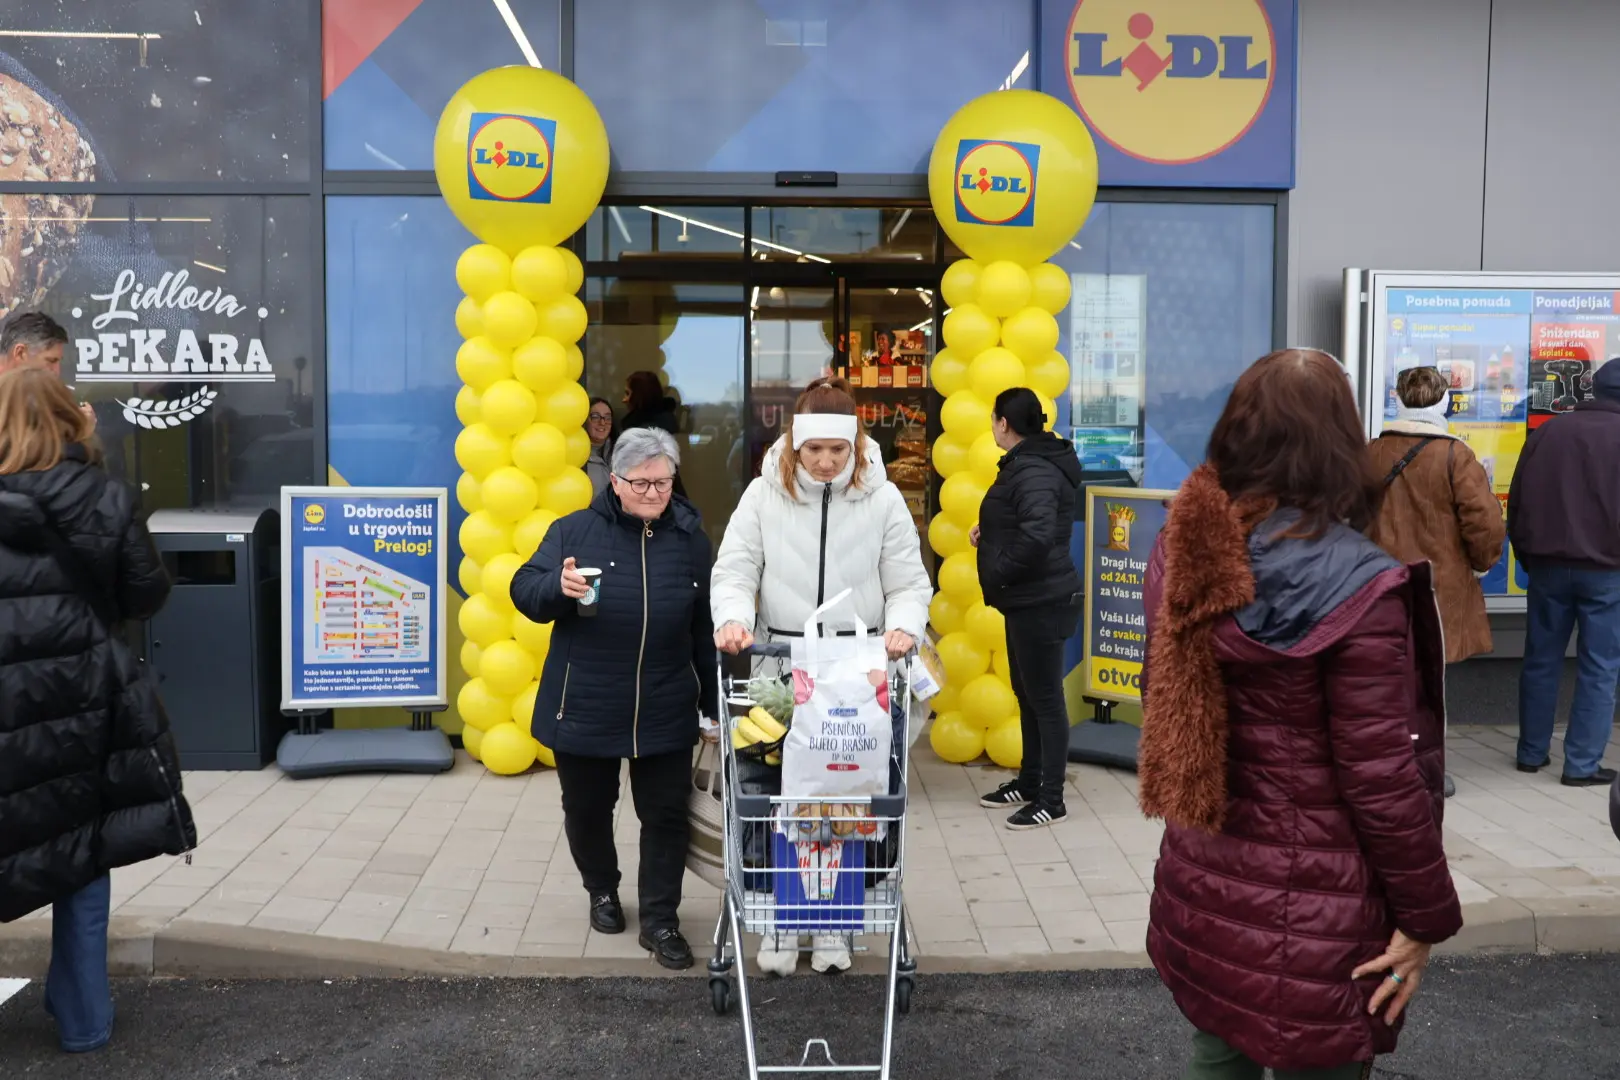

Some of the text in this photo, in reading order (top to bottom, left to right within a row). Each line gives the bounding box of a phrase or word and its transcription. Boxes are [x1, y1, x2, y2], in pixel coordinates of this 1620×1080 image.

[90, 268, 247, 330] Lidlova
[1405, 294, 1511, 310] Posebna ponuda
[1535, 295, 1612, 311] Ponedjeljak
[1540, 326, 1600, 339] Snižendan
[75, 328, 273, 373] PEKARA
[863, 404, 921, 428] ULAZ
[343, 504, 432, 518] Dobrodošli
[349, 522, 432, 538] u trgovinu
[374, 539, 432, 556] Prelog!
[1101, 556, 1148, 572] Dragi kup
[1101, 572, 1113, 582] od
[1115, 572, 1140, 585] 24.11.
[1100, 587, 1111, 596] za
[1113, 587, 1130, 598] Vas
[1100, 610, 1123, 624] Vaša
[1100, 626, 1111, 637] će
[1113, 629, 1141, 641] svake
[1100, 641, 1113, 653] do
[1114, 643, 1139, 659] kraja
[1098, 667, 1140, 689] otvo
[821, 721, 866, 736] PŠENIČNO
[809, 736, 878, 752] BIJELO BRAŠNO
